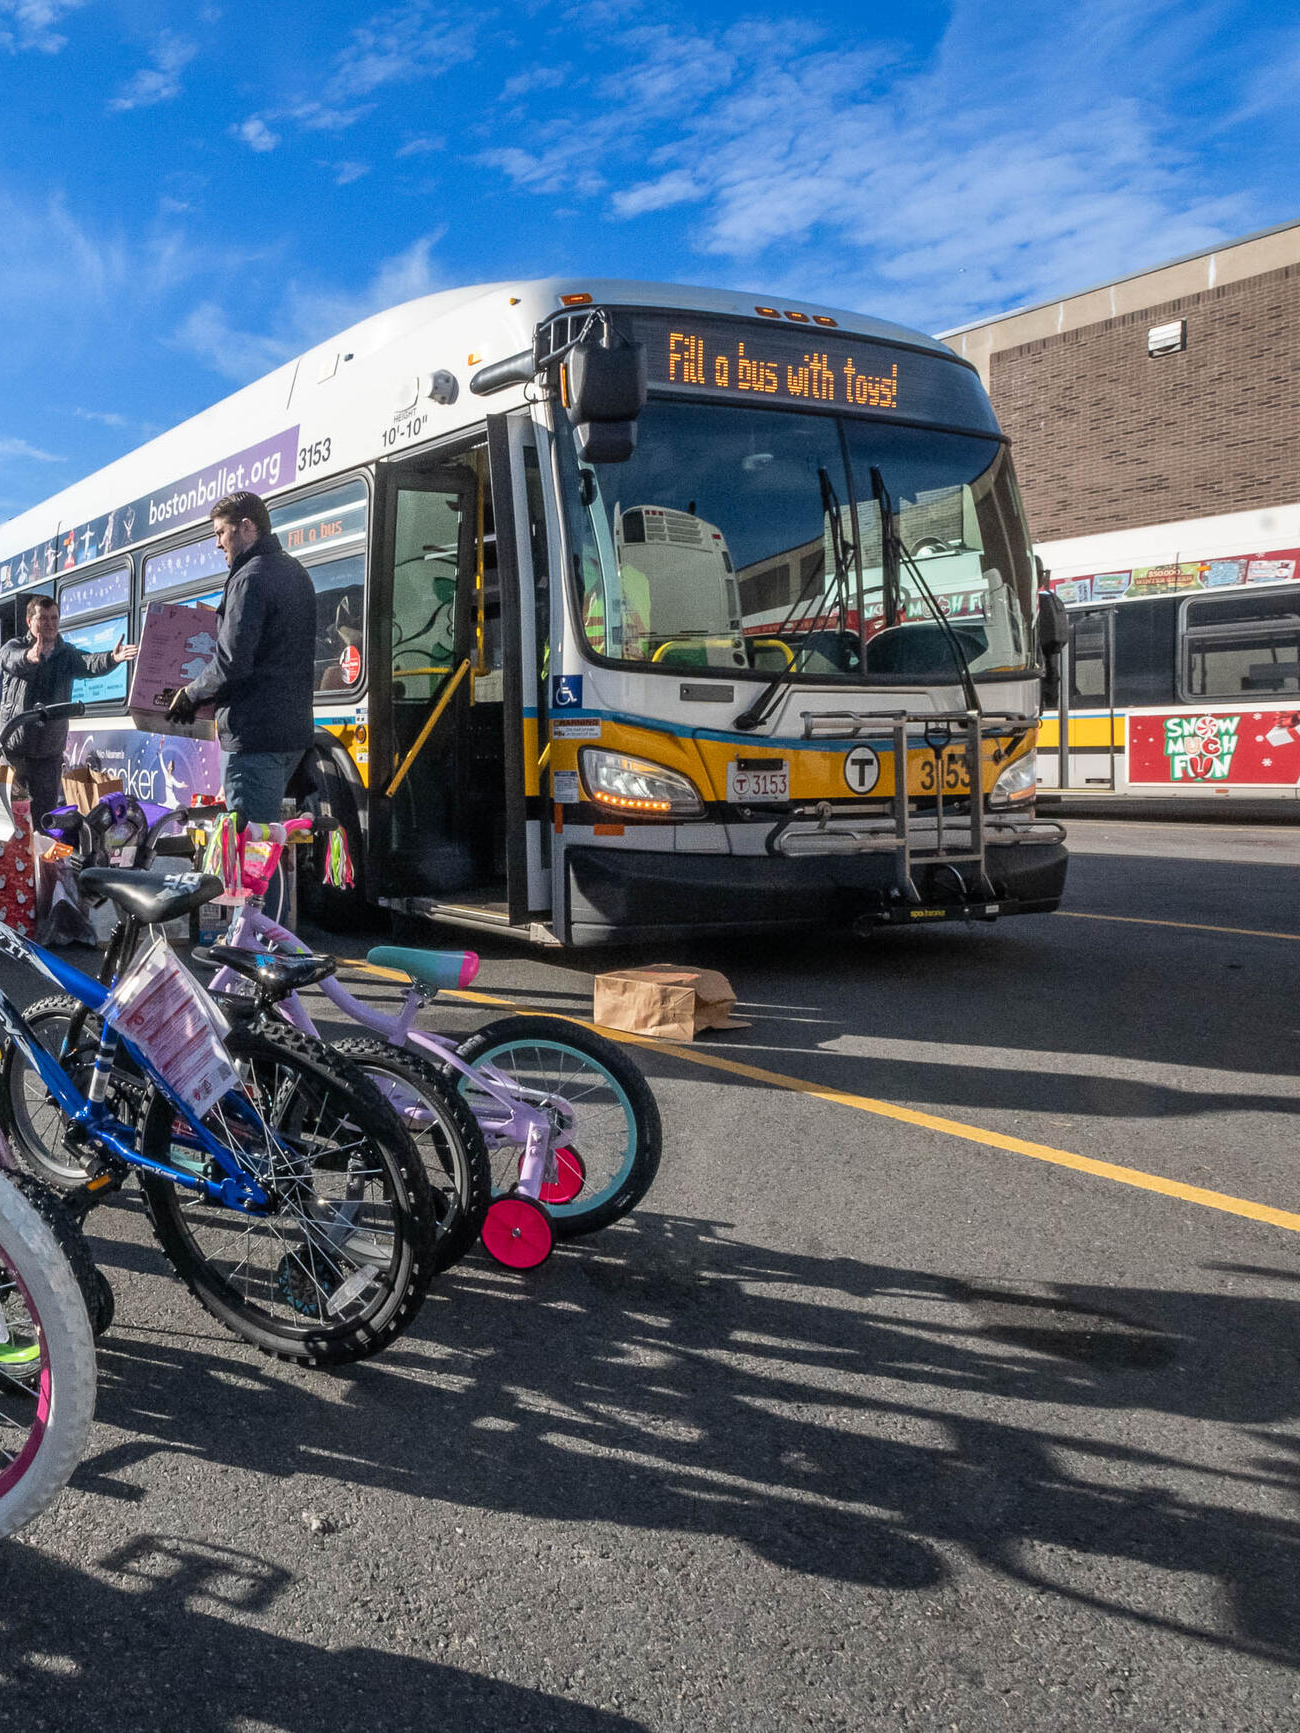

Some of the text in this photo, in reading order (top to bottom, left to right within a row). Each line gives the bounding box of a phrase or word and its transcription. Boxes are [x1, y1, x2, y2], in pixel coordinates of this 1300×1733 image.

[670, 332, 897, 408] Fill a bus with toys!
[382, 414, 428, 447] 10'-10"
[298, 437, 332, 472] 3153
[149, 451, 282, 526] bostonballet.org
[1164, 716, 1241, 738] SNOW
[1165, 735, 1239, 756] MUCH
[1171, 754, 1233, 781] FUN
[752, 774, 787, 795] 3153
[5, 941, 30, 960] IT
